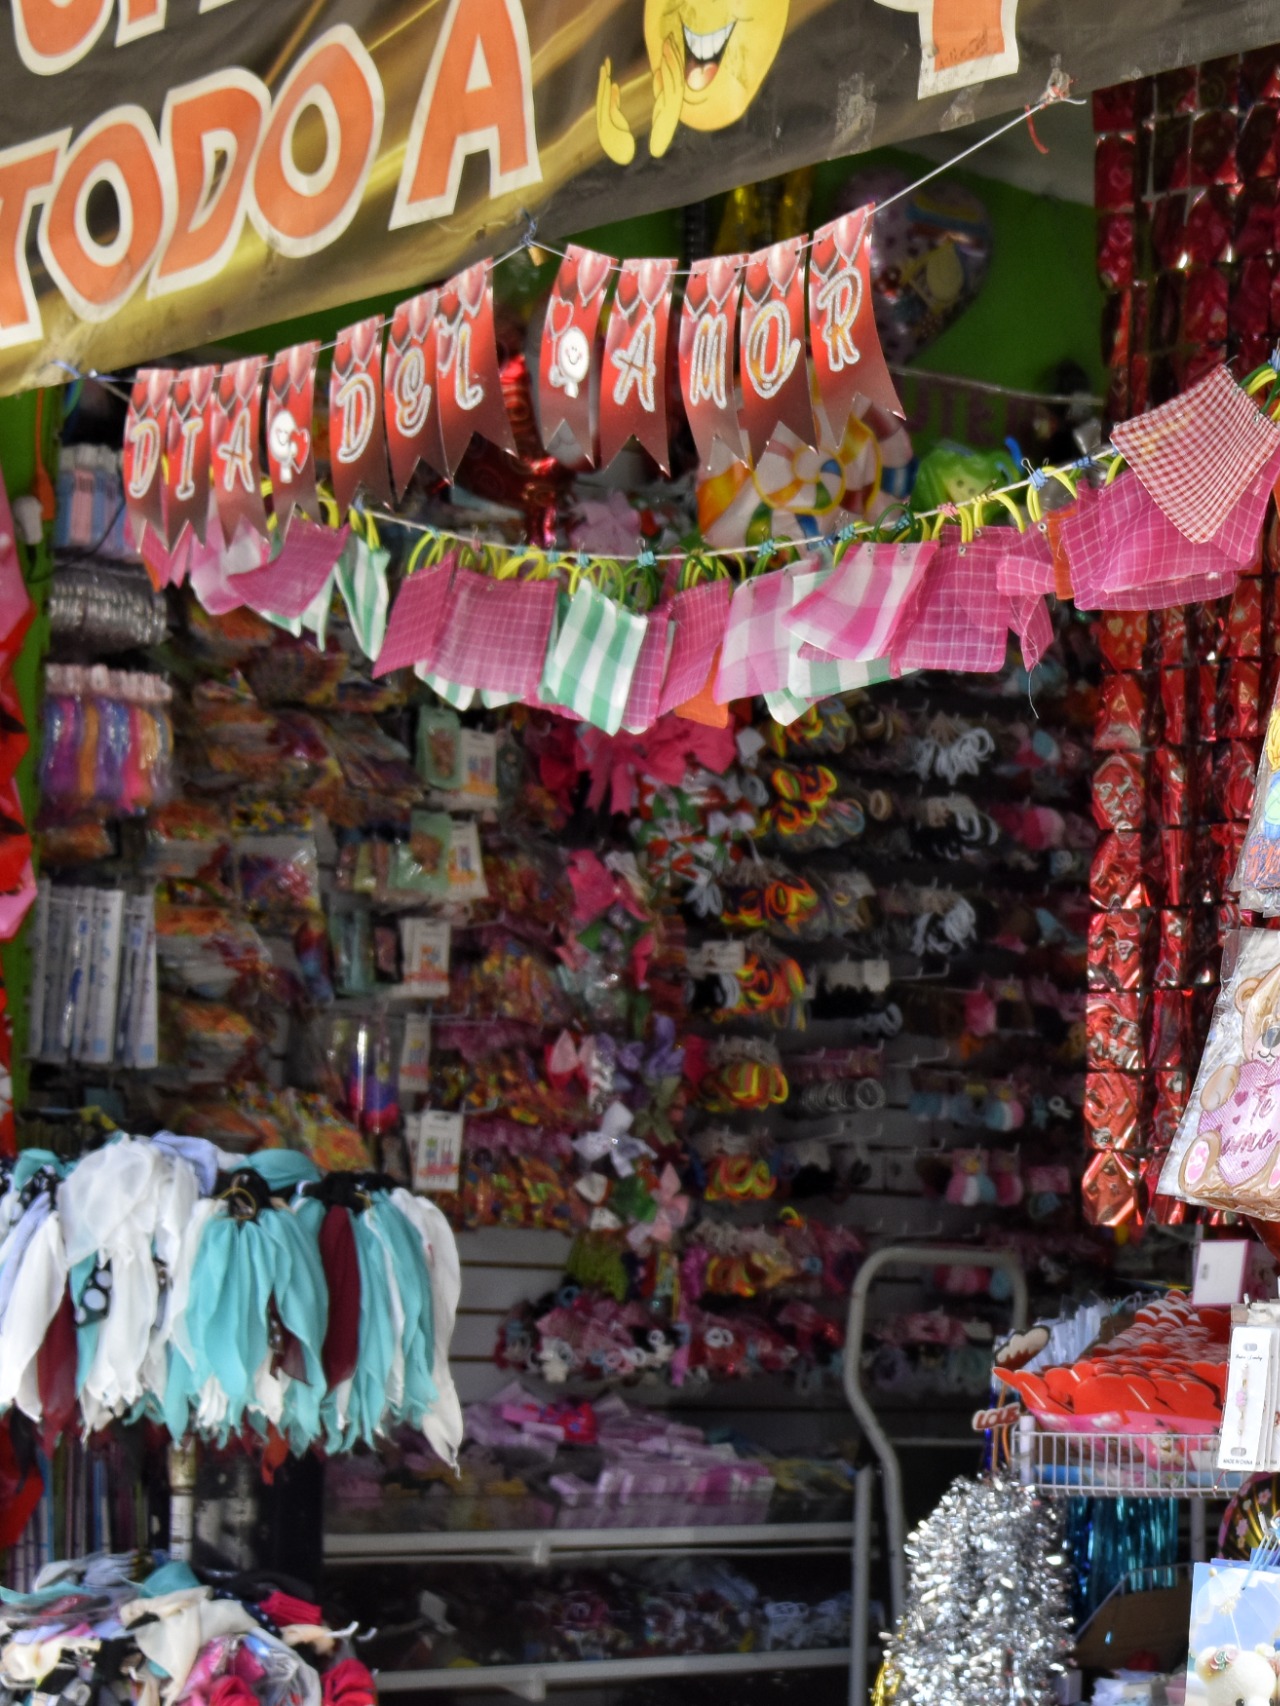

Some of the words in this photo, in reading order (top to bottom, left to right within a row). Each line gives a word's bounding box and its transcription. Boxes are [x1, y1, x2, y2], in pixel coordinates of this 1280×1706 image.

[389, 0, 542, 230] A
[128, 408, 255, 500] DIA
[336, 322, 484, 464] DEL
[611, 266, 863, 413] AMOR
